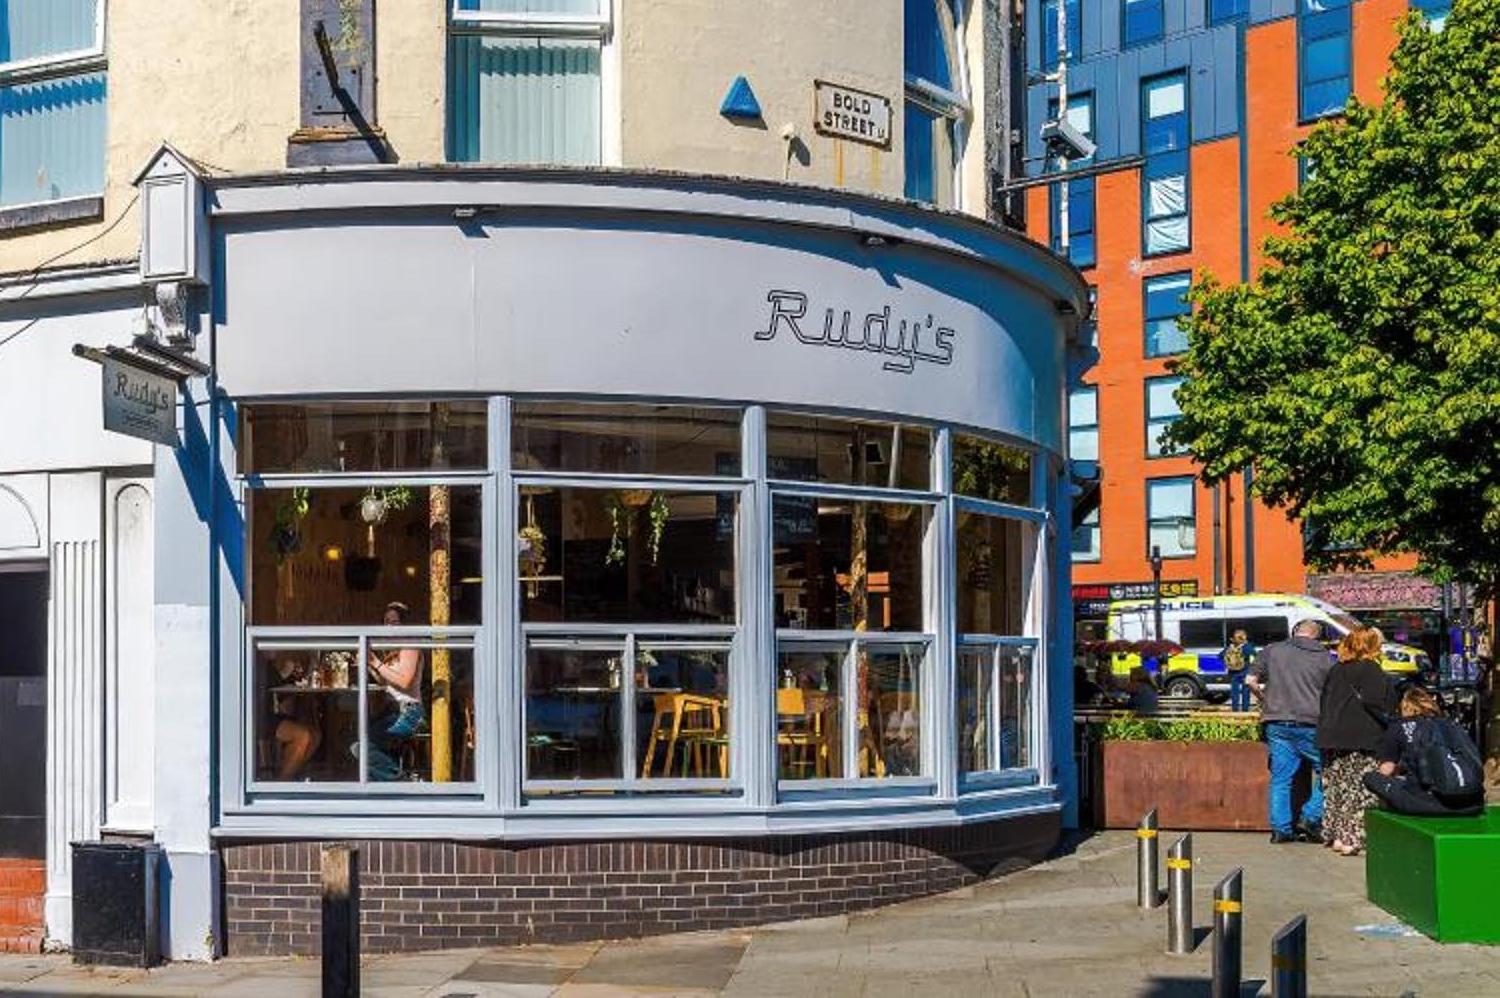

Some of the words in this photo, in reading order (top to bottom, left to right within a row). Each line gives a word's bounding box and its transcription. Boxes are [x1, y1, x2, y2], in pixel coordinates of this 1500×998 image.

[834, 93, 870, 114] BOLD
[823, 111, 875, 136] STREET
[754, 289, 955, 374] Rudy's
[113, 372, 169, 414] Rudy's
[1138, 601, 1214, 611] POLICE
